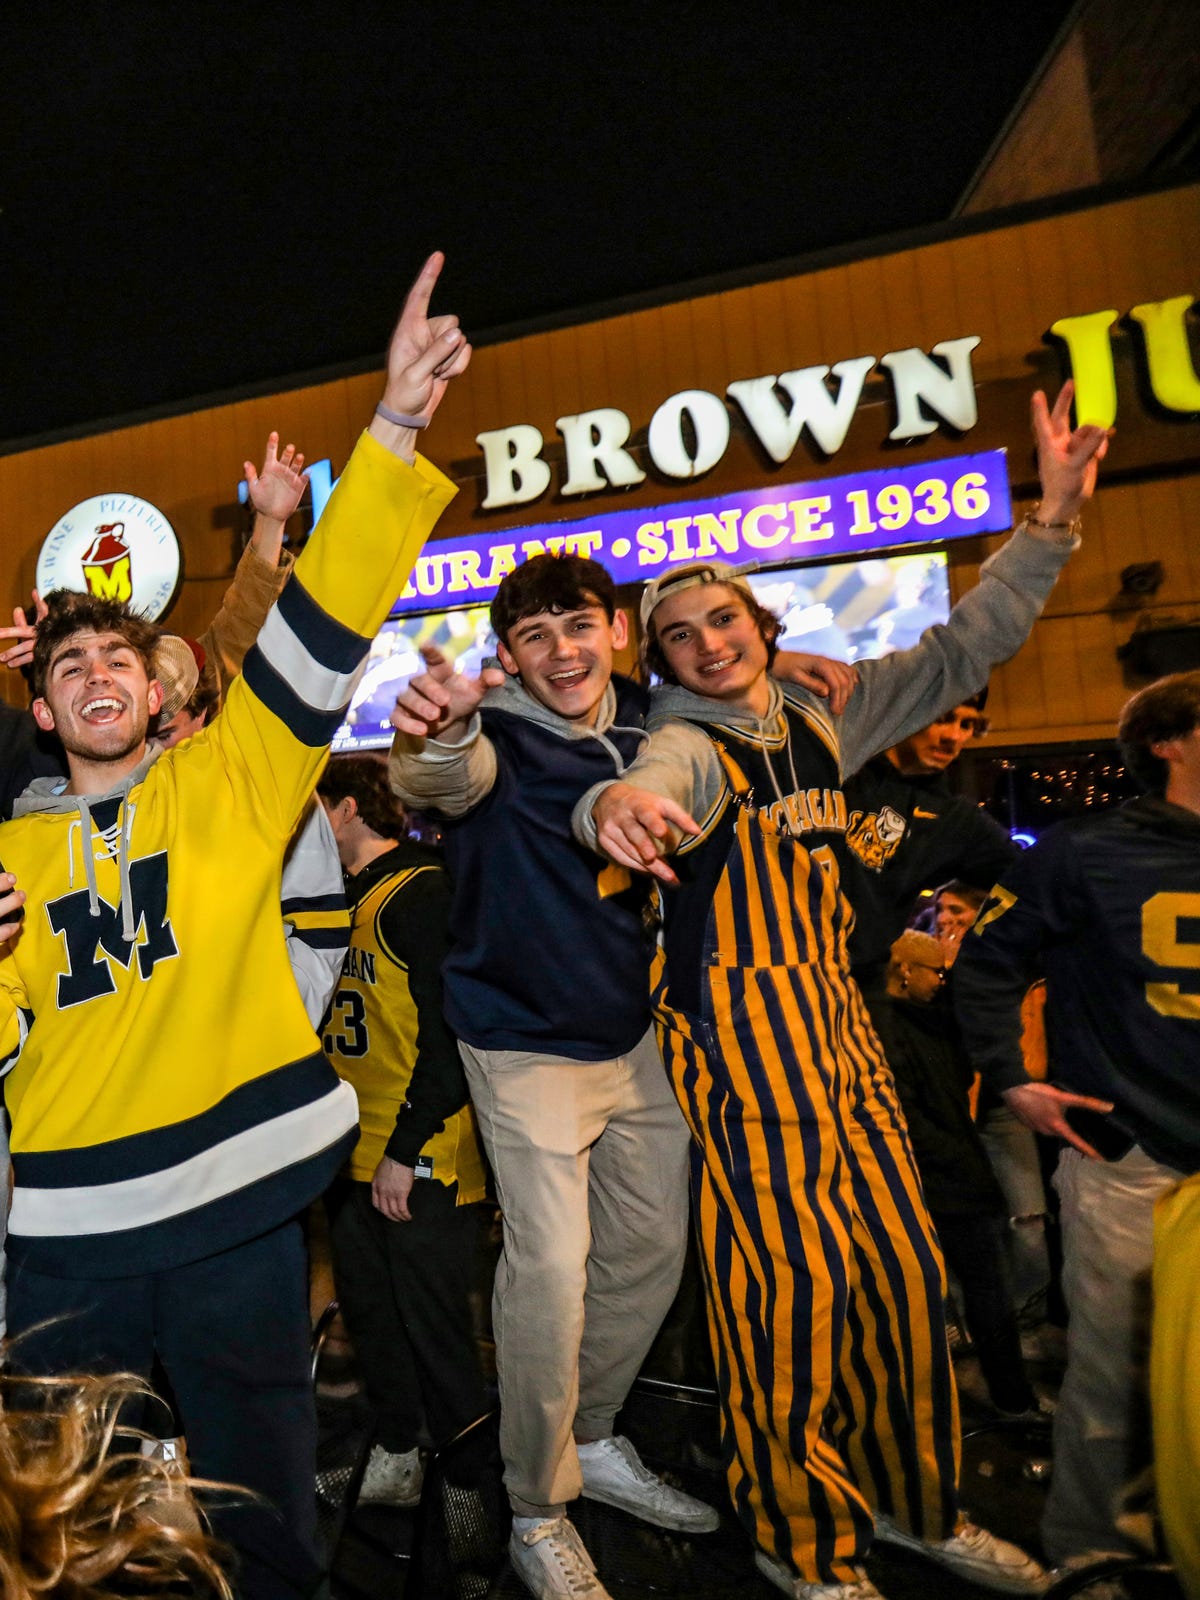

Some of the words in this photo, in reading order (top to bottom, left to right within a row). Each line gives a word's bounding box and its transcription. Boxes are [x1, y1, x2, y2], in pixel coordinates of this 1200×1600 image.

[475, 336, 982, 510] BROWN
[44, 520, 74, 568] WINE
[635, 495, 834, 566] SINCE
[846, 472, 992, 537] 1936
[44, 849, 181, 1010] M
